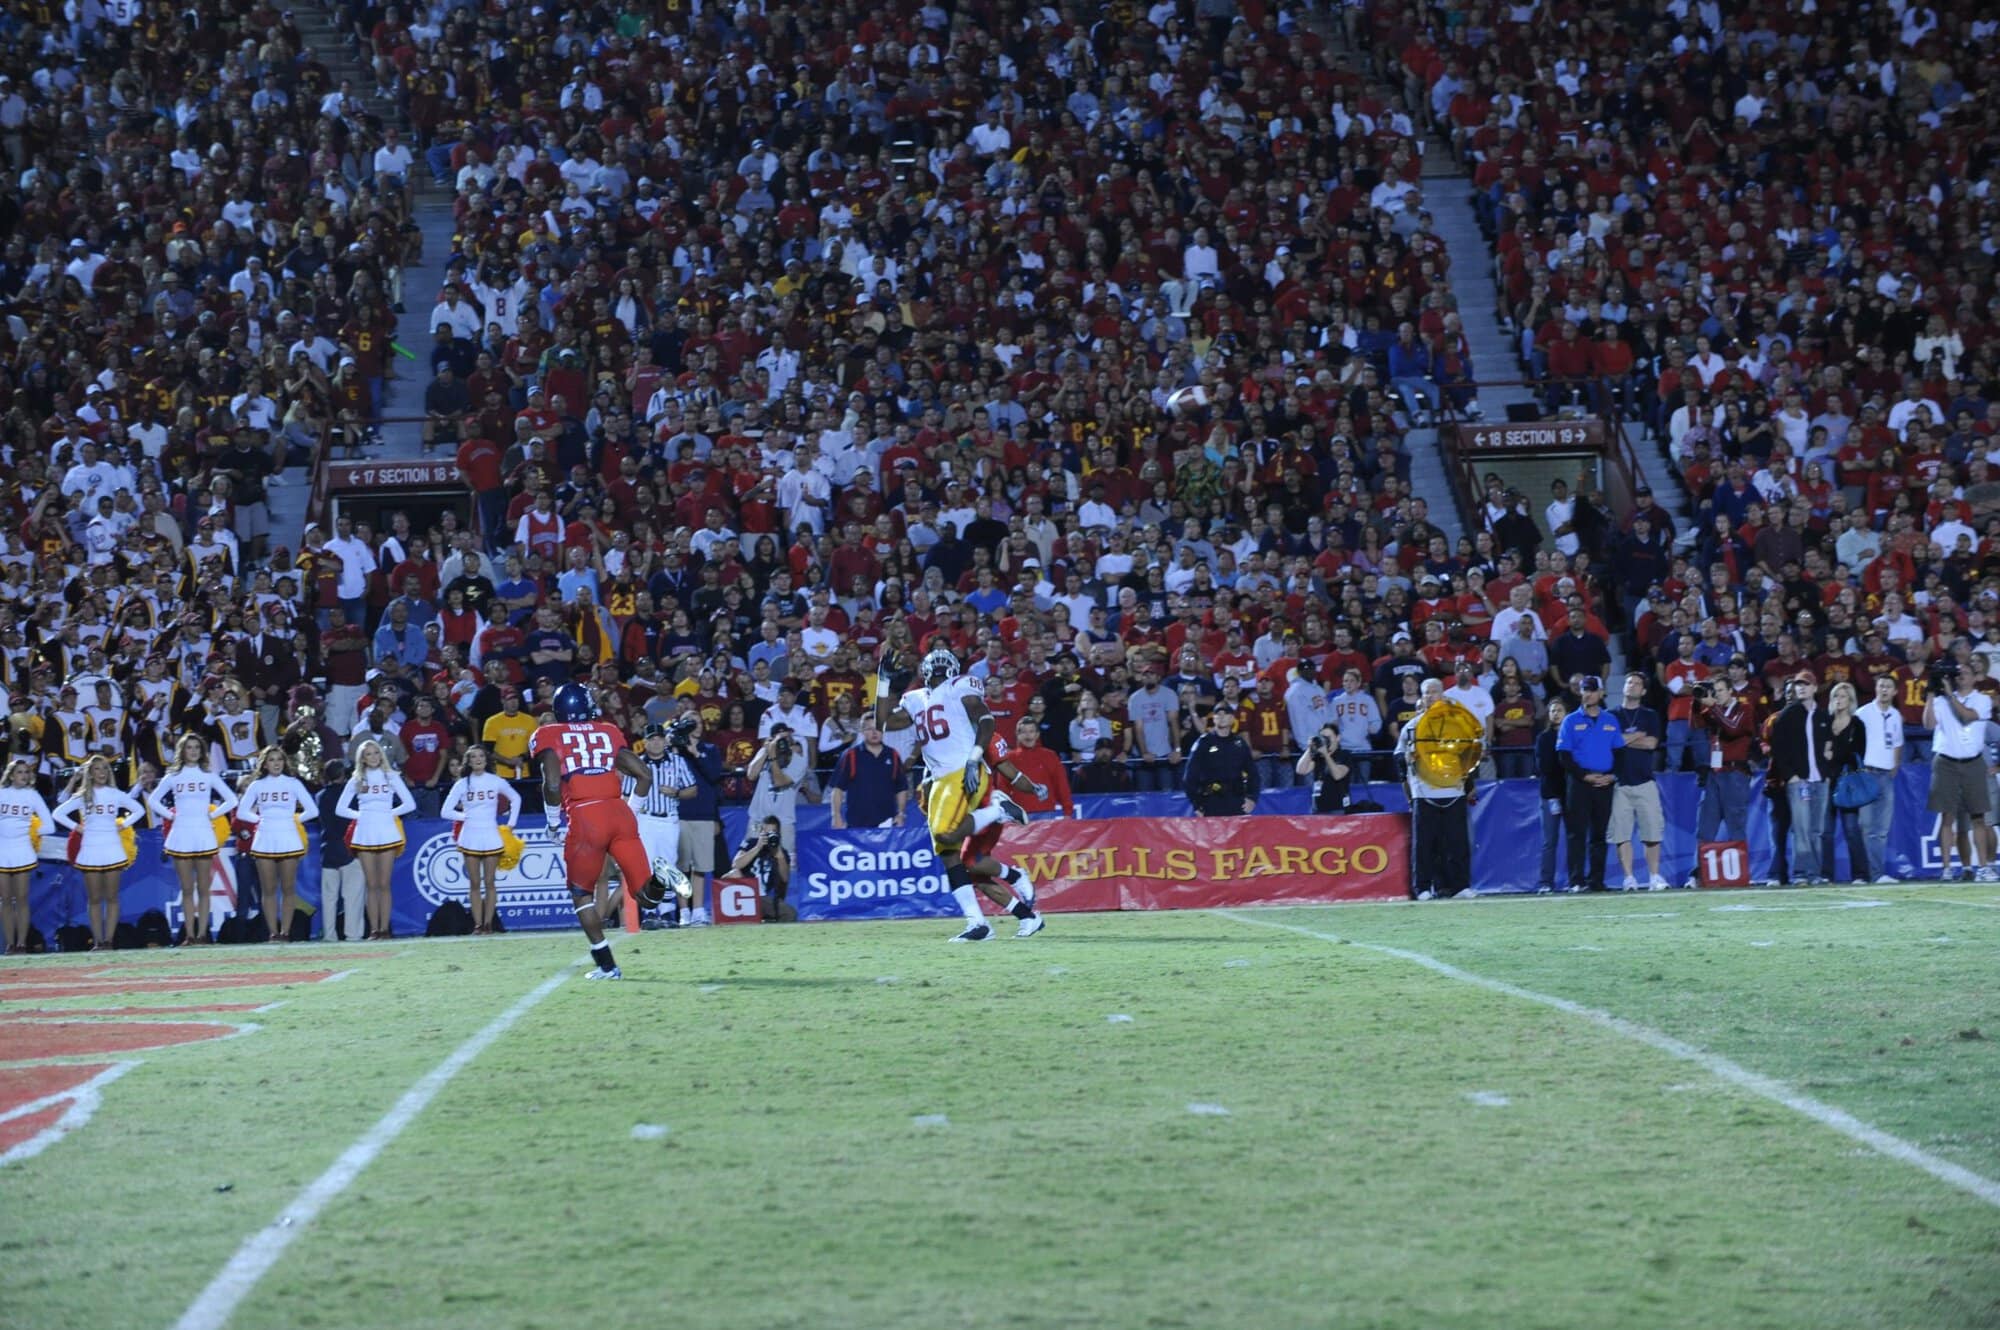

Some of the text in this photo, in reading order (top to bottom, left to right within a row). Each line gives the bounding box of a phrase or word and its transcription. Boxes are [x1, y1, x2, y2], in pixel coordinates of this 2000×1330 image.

[496, 298, 506, 316] 8
[1505, 430, 1556, 445] SECTION
[1560, 429, 1573, 444] 19
[364, 470, 375, 484] 17
[379, 468, 429, 484] SECTION
[610, 593, 636, 616] 23
[1336, 703, 1369, 717] USC
[914, 704, 950, 747] 86
[562, 732, 615, 773] 32
[176, 782, 206, 793] USC
[361, 784, 389, 794] SC
[467, 790, 495, 801] USC
[261, 791, 289, 802] USC
[1, 803, 30, 816] USC
[829, 845, 933, 872] Game
[1012, 845, 1389, 881] WELLS FARGO
[1703, 848, 1741, 880] 10
[808, 872, 949, 905] Sponsor
[720, 885, 756, 917] G
[507, 909, 522, 917] OF
[528, 907, 550, 916] THE
